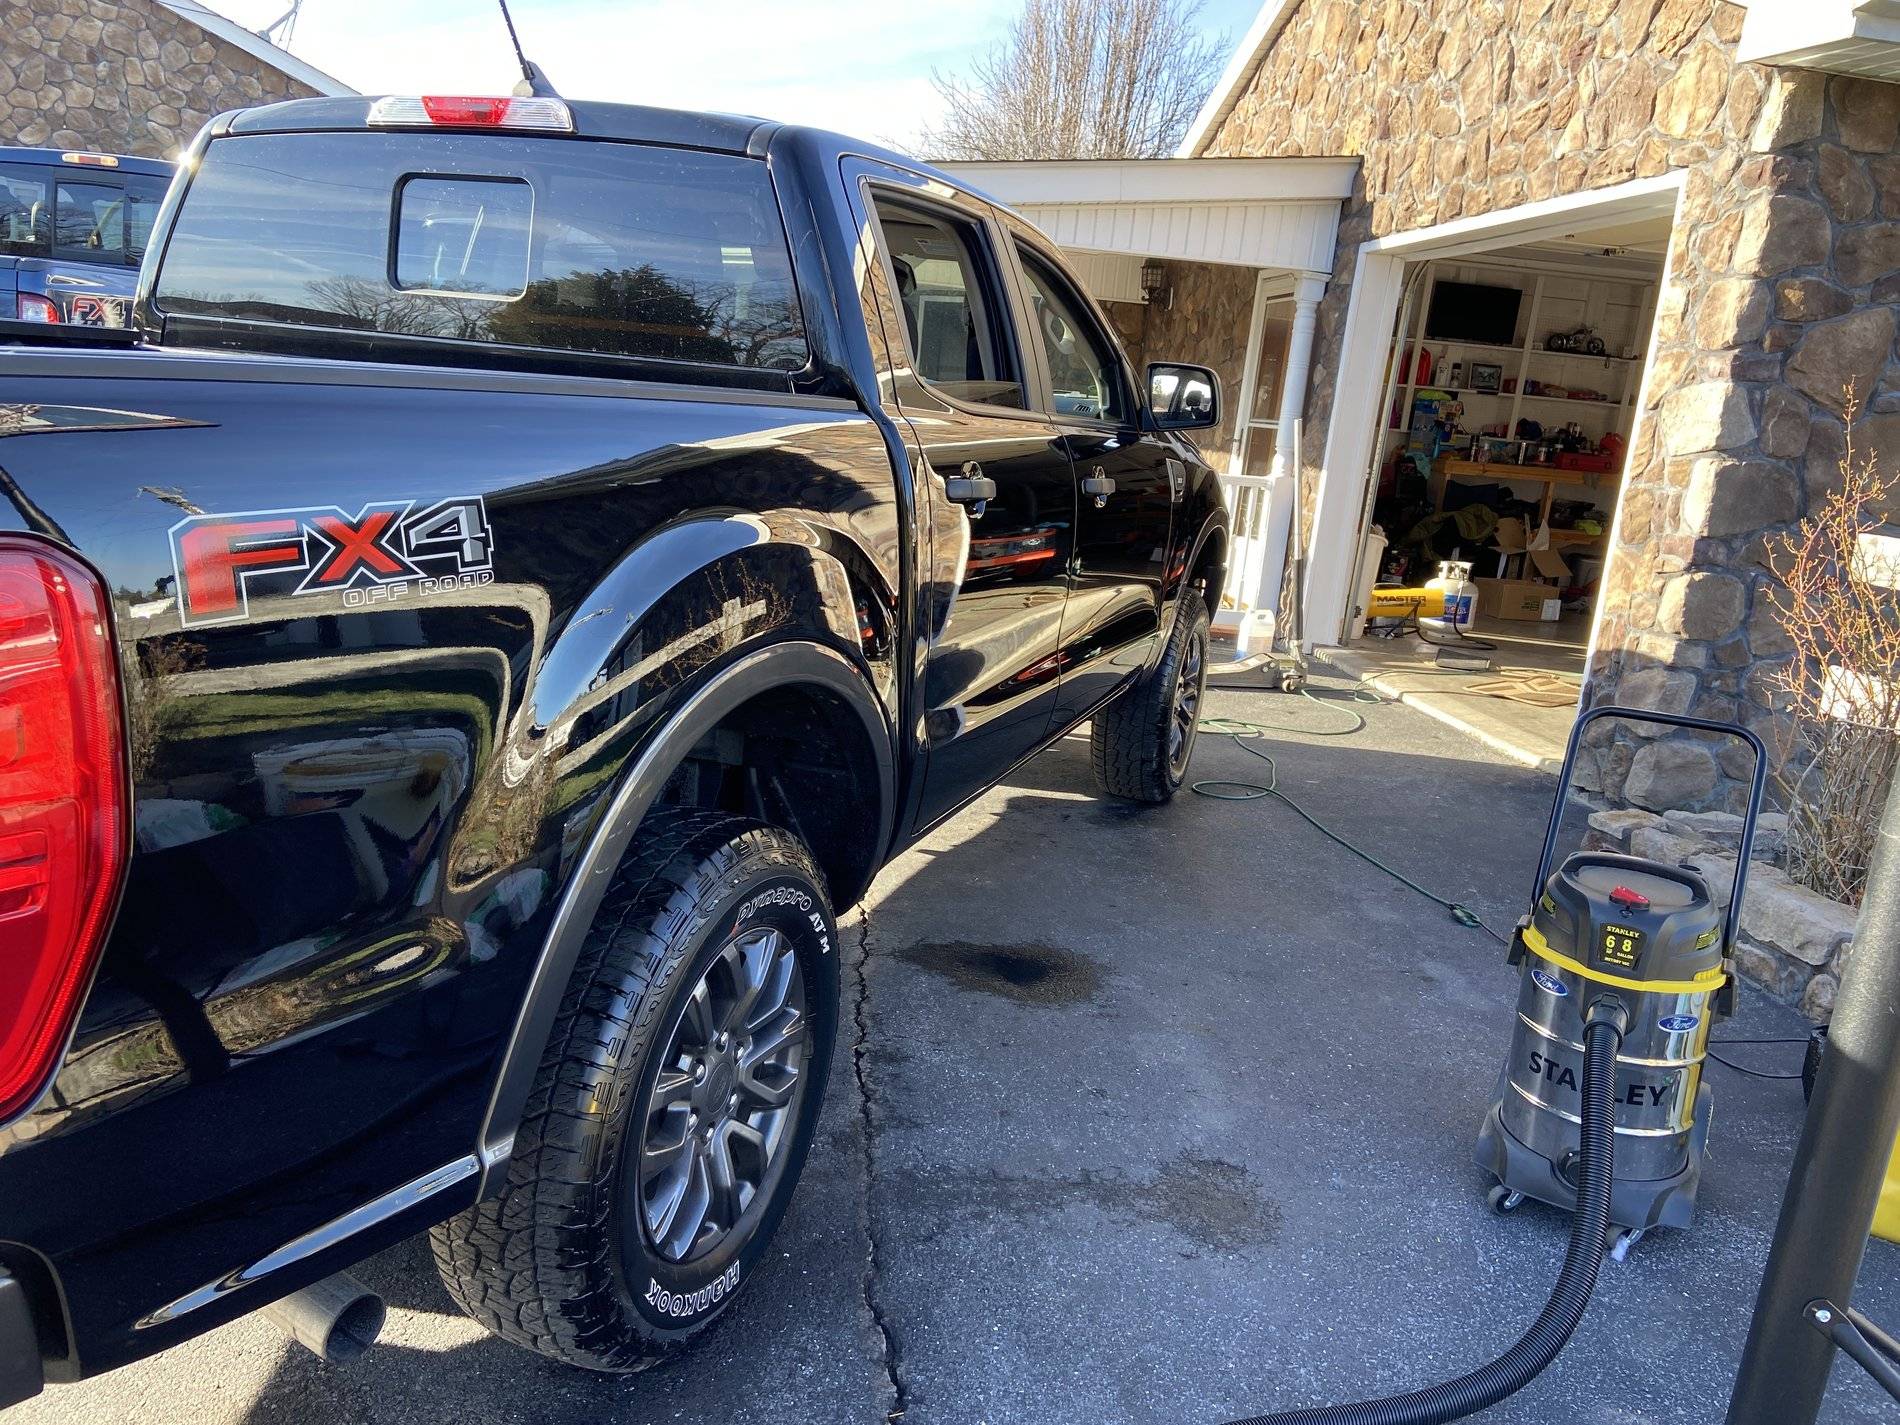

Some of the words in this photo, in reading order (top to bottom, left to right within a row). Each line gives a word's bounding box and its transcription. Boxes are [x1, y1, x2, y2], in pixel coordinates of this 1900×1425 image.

[71, 295, 126, 321] FX4
[169, 495, 494, 628] FX4
[343, 582, 408, 607] OFF
[419, 570, 494, 595] ROAD
[1376, 595, 1426, 603] MASTER
[1606, 925, 1640, 938] STANLEY
[820, 935, 830, 954] M
[1606, 935, 1616, 948] 6
[1622, 939, 1632, 952] 8
[1529, 1051, 1668, 1106] STAEY
